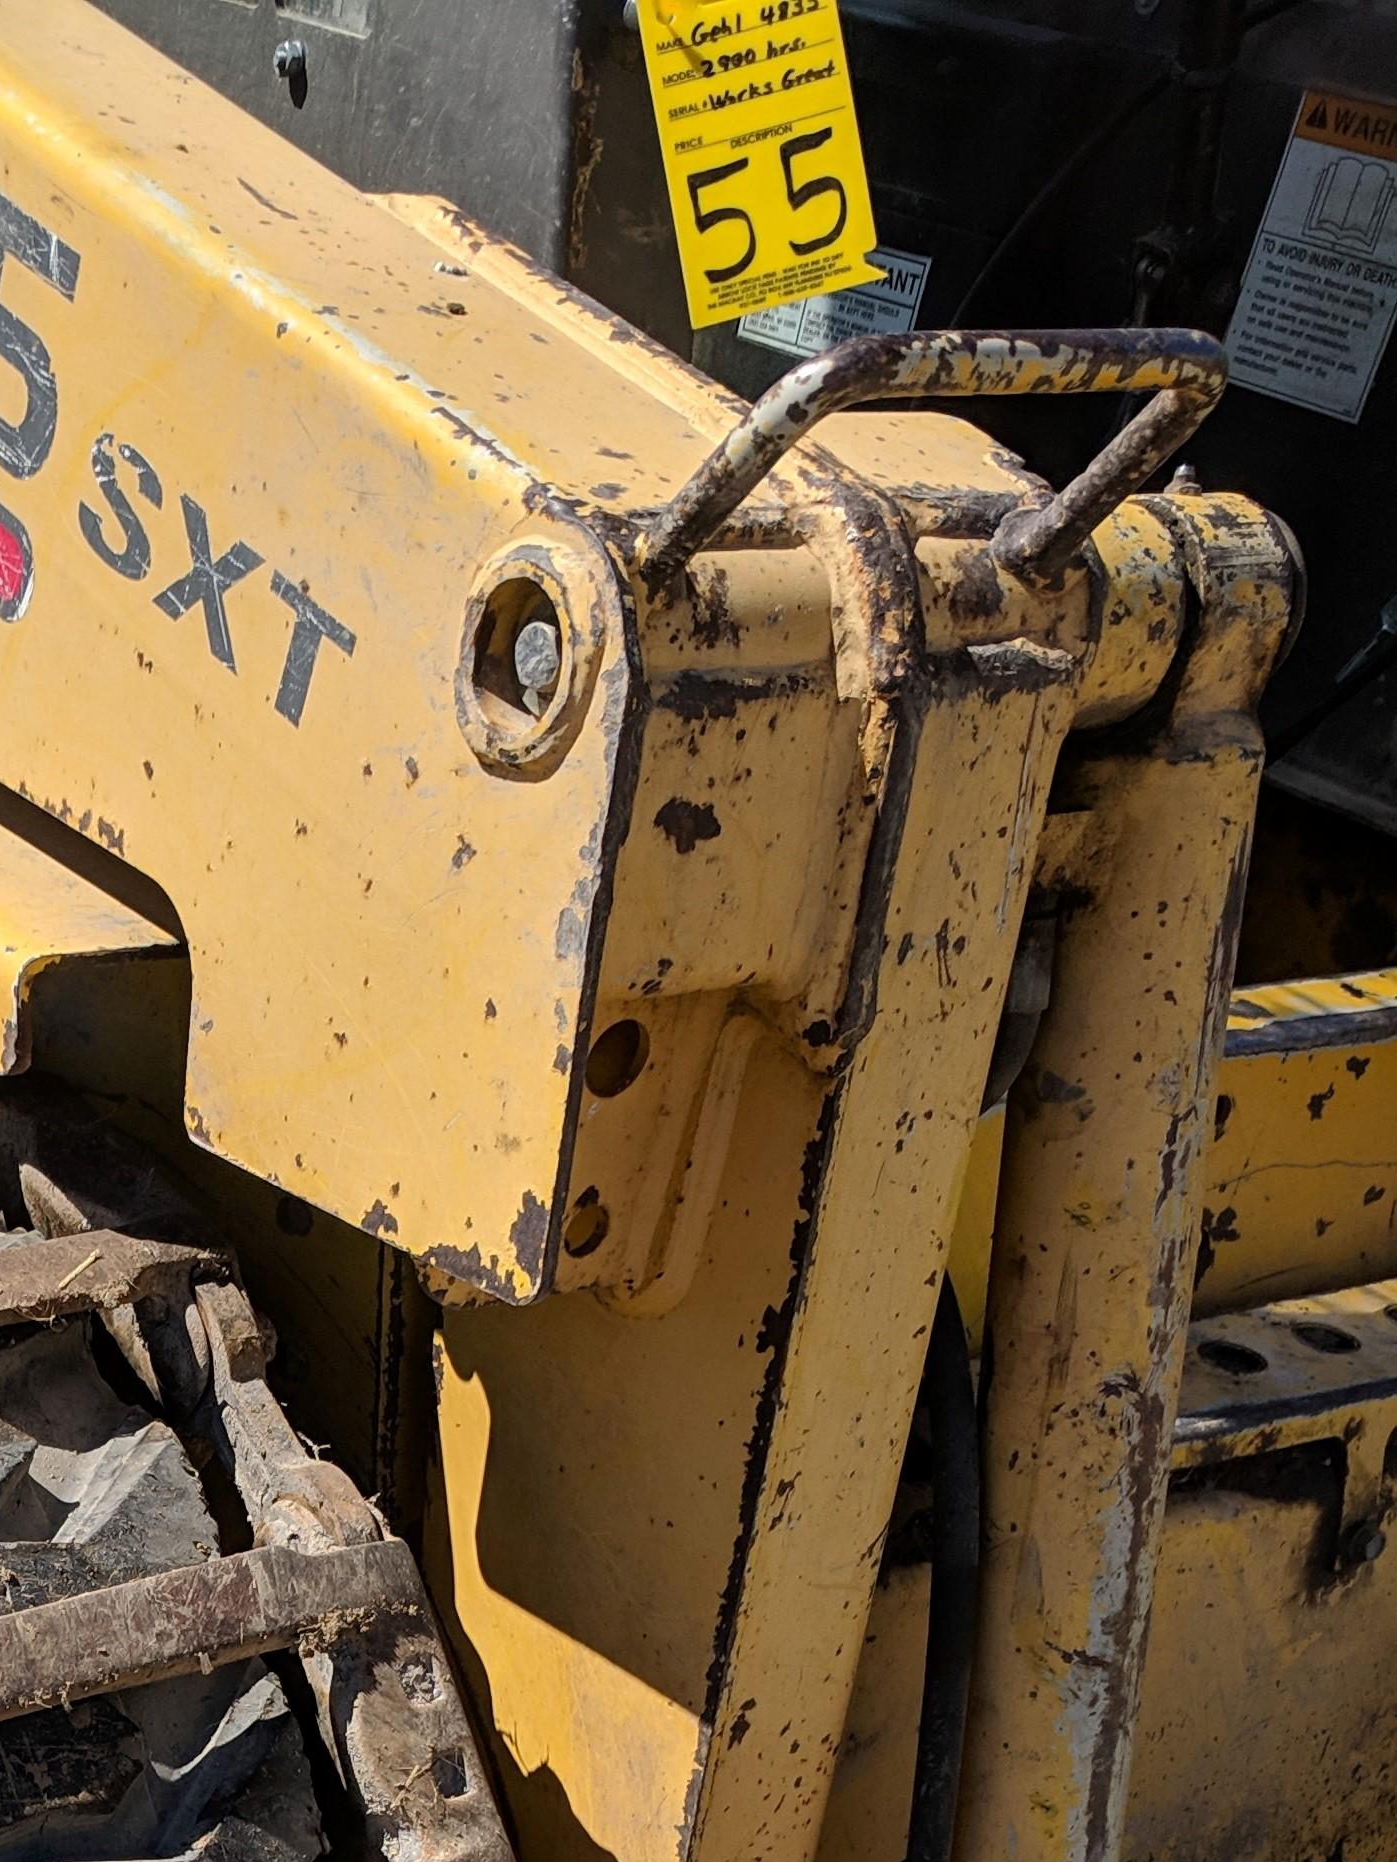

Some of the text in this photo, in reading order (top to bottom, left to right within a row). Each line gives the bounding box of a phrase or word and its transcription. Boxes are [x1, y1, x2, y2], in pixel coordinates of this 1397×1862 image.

[691, 13, 742, 47] Gehl
[708, 60, 836, 111] Works Great
[669, 102, 700, 118] SERIAL
[674, 123, 793, 152] PRICE DESCRIPTION
[1261, 237, 1275, 253] TO
[1276, 242, 1307, 262] AVOID
[1308, 252, 1344, 272] INJURY
[1345, 261, 1362, 277] OR
[78, 433, 358, 729] SXT
